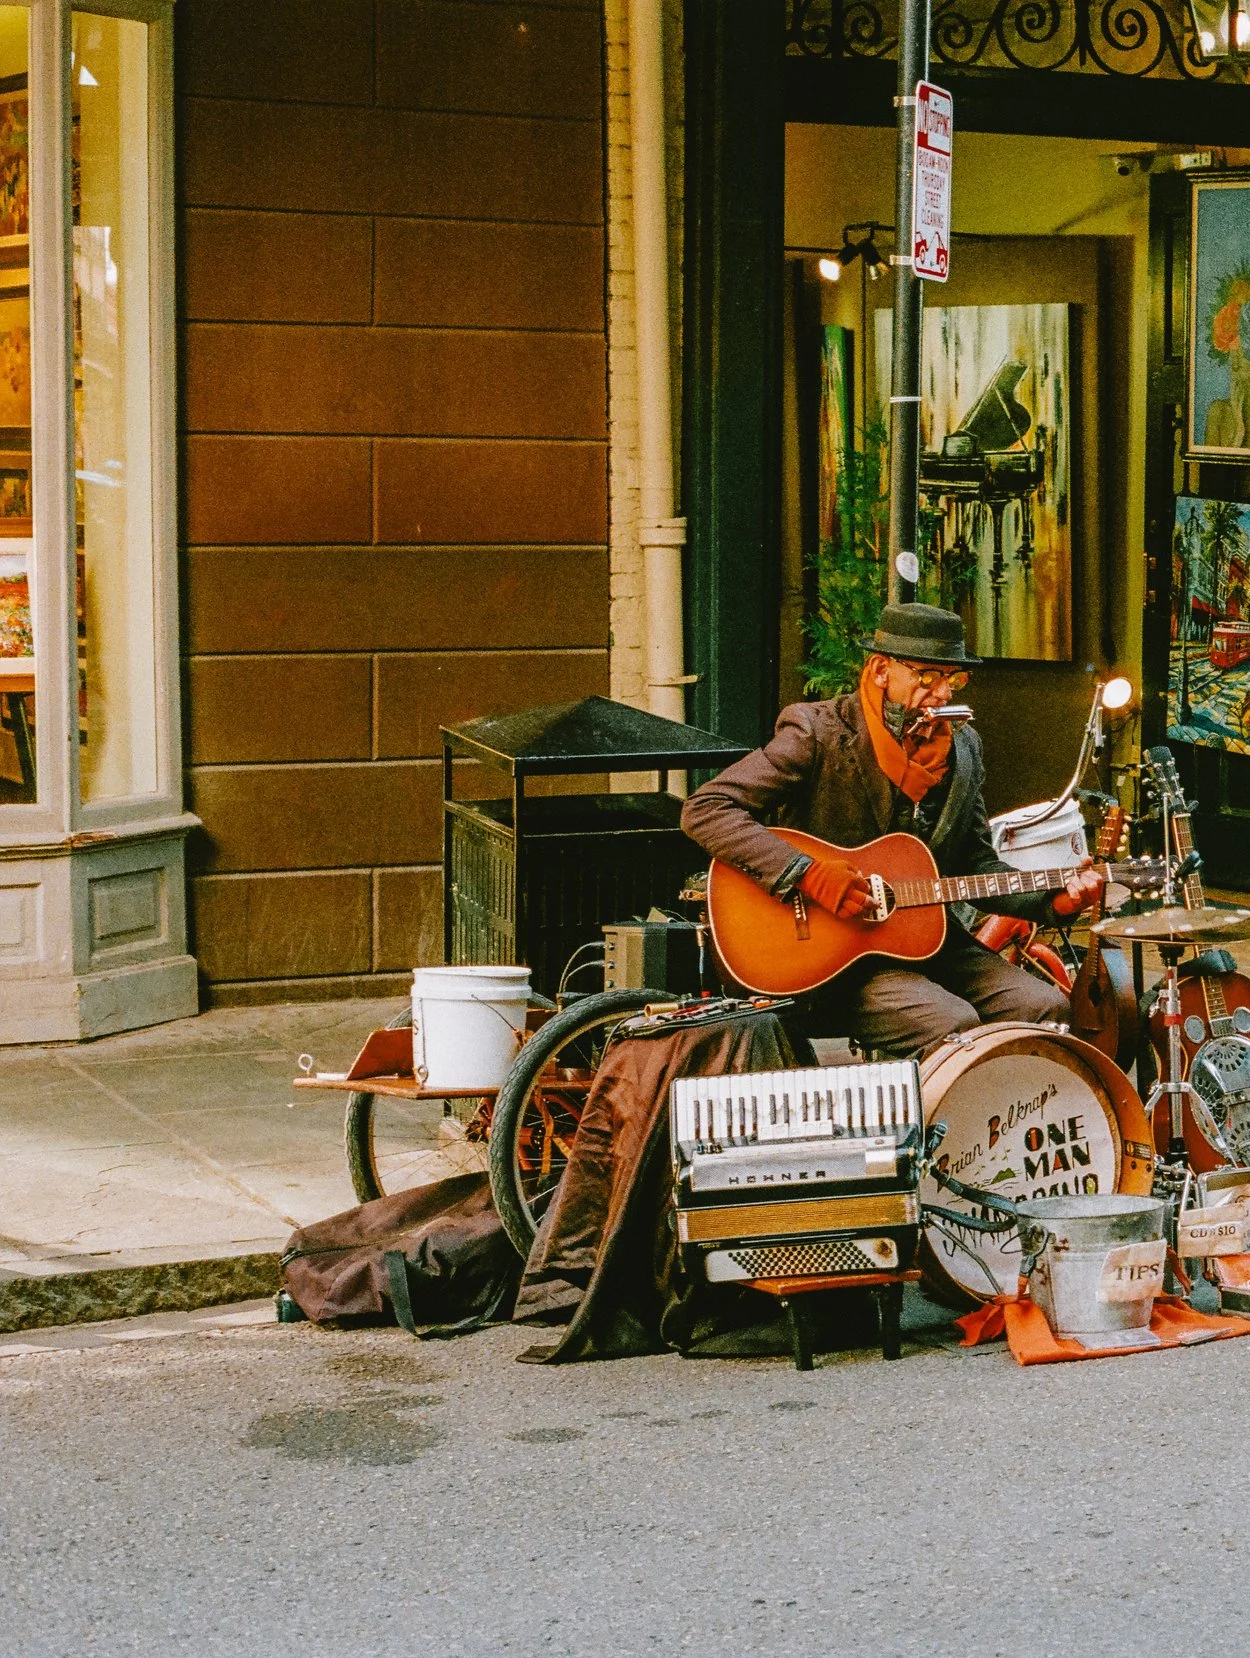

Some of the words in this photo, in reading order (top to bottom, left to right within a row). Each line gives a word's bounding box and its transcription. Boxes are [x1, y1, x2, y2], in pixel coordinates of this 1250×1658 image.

[918, 100, 928, 134] NO
[936, 1142, 983, 1193] Brian
[987, 1083, 1058, 1150] Belknap's
[1024, 1114, 1087, 1152] ONE
[1023, 1141, 1091, 1182] MAN
[1218, 1225, 1236, 1237] $10
[1114, 1263, 1161, 1281] TIPS
